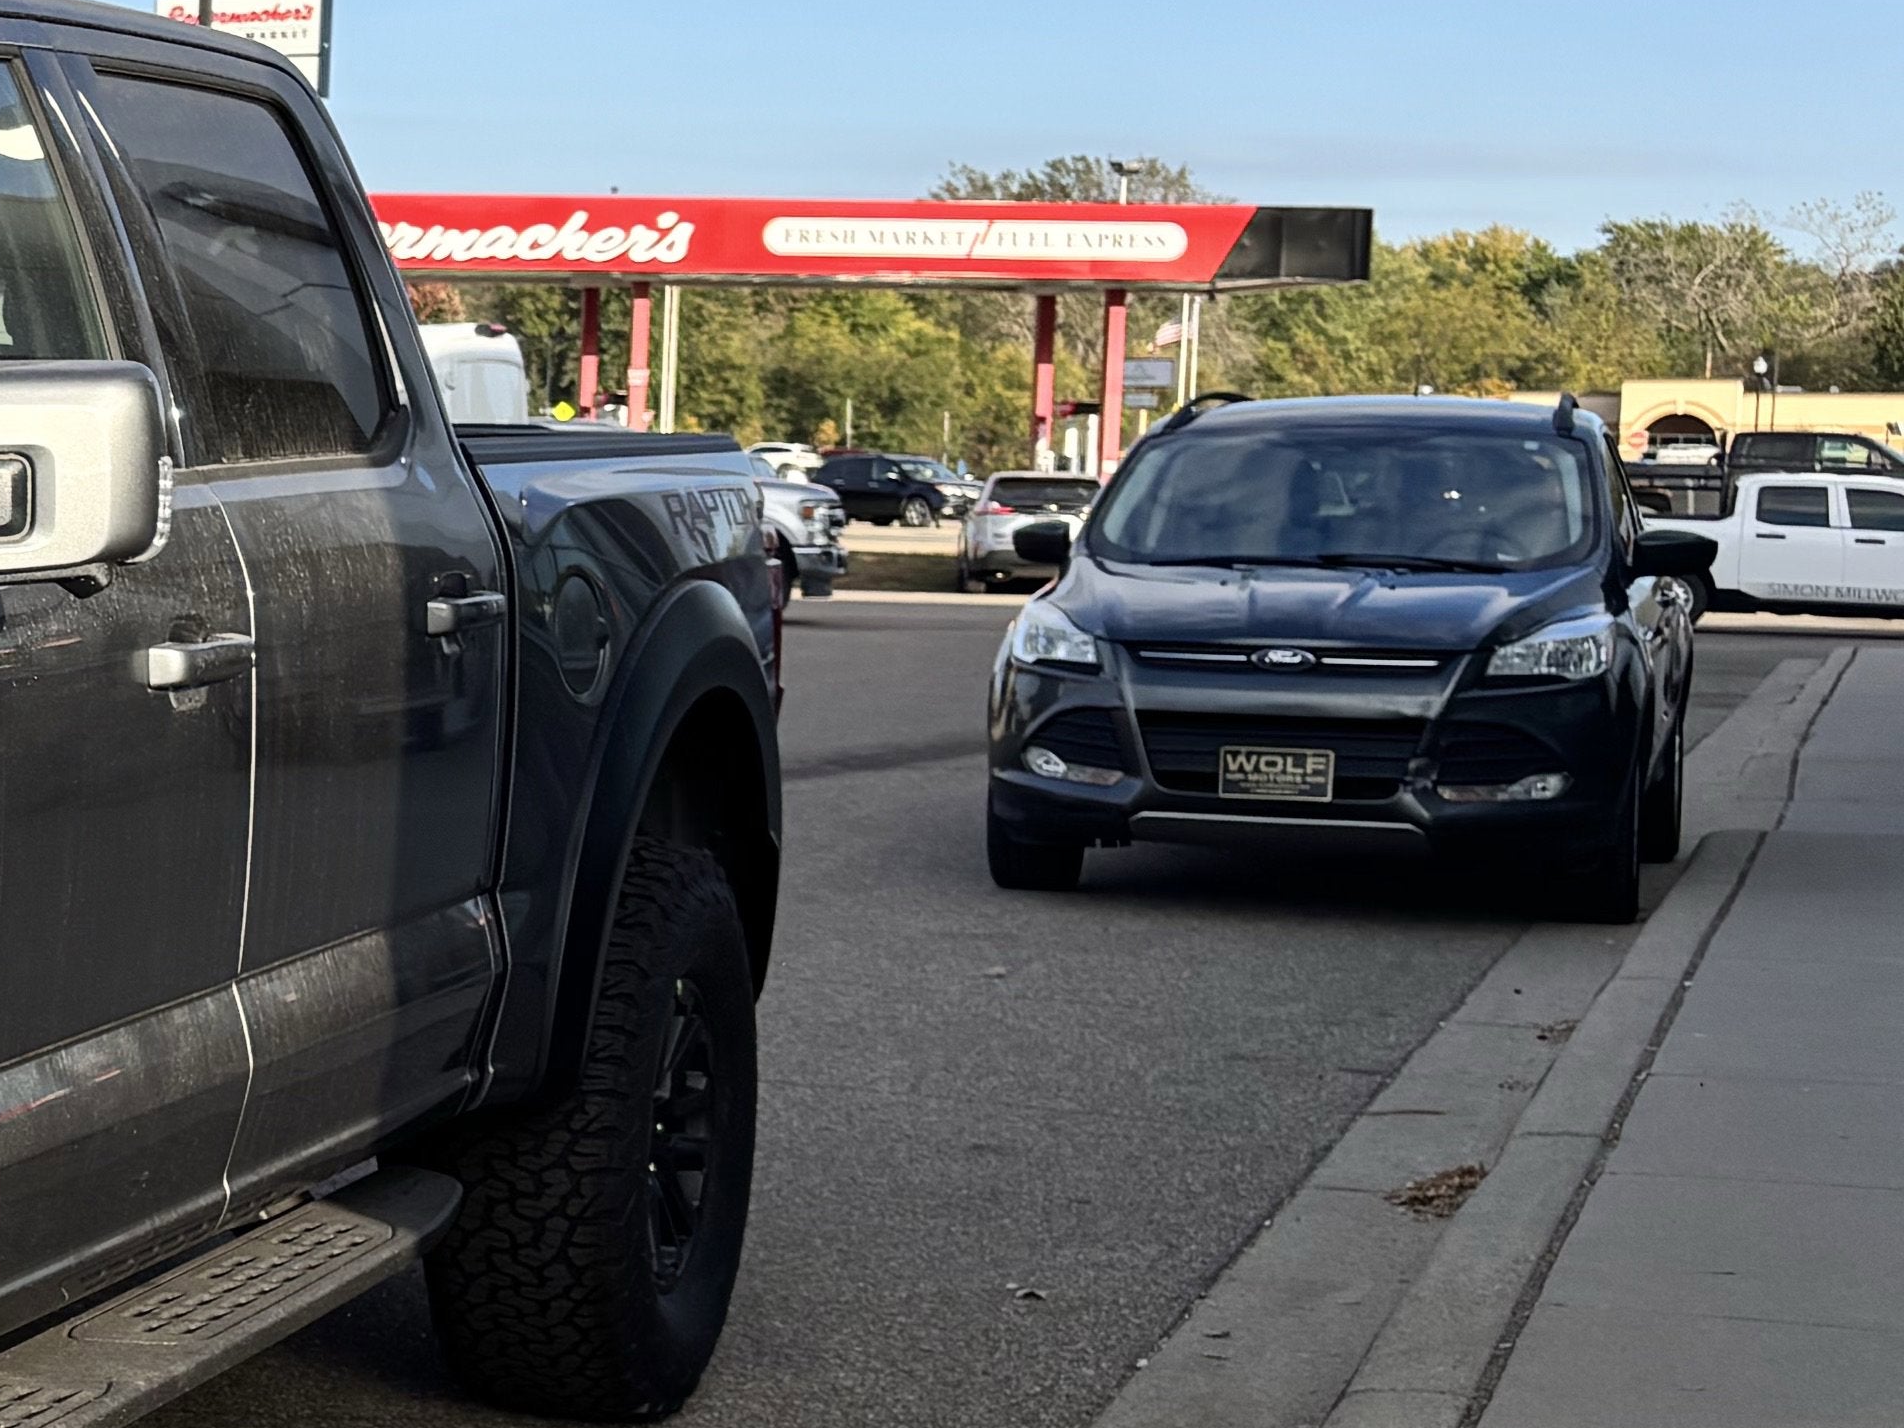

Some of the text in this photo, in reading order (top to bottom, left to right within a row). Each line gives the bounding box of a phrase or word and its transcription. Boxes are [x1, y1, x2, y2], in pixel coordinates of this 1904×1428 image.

[783, 228, 1168, 250] FRESH MARKET FUEL EXPRESS
[661, 487, 756, 544] RAPTOR
[1767, 583, 1830, 598] SIMON
[1226, 752, 1327, 774] WOLF
